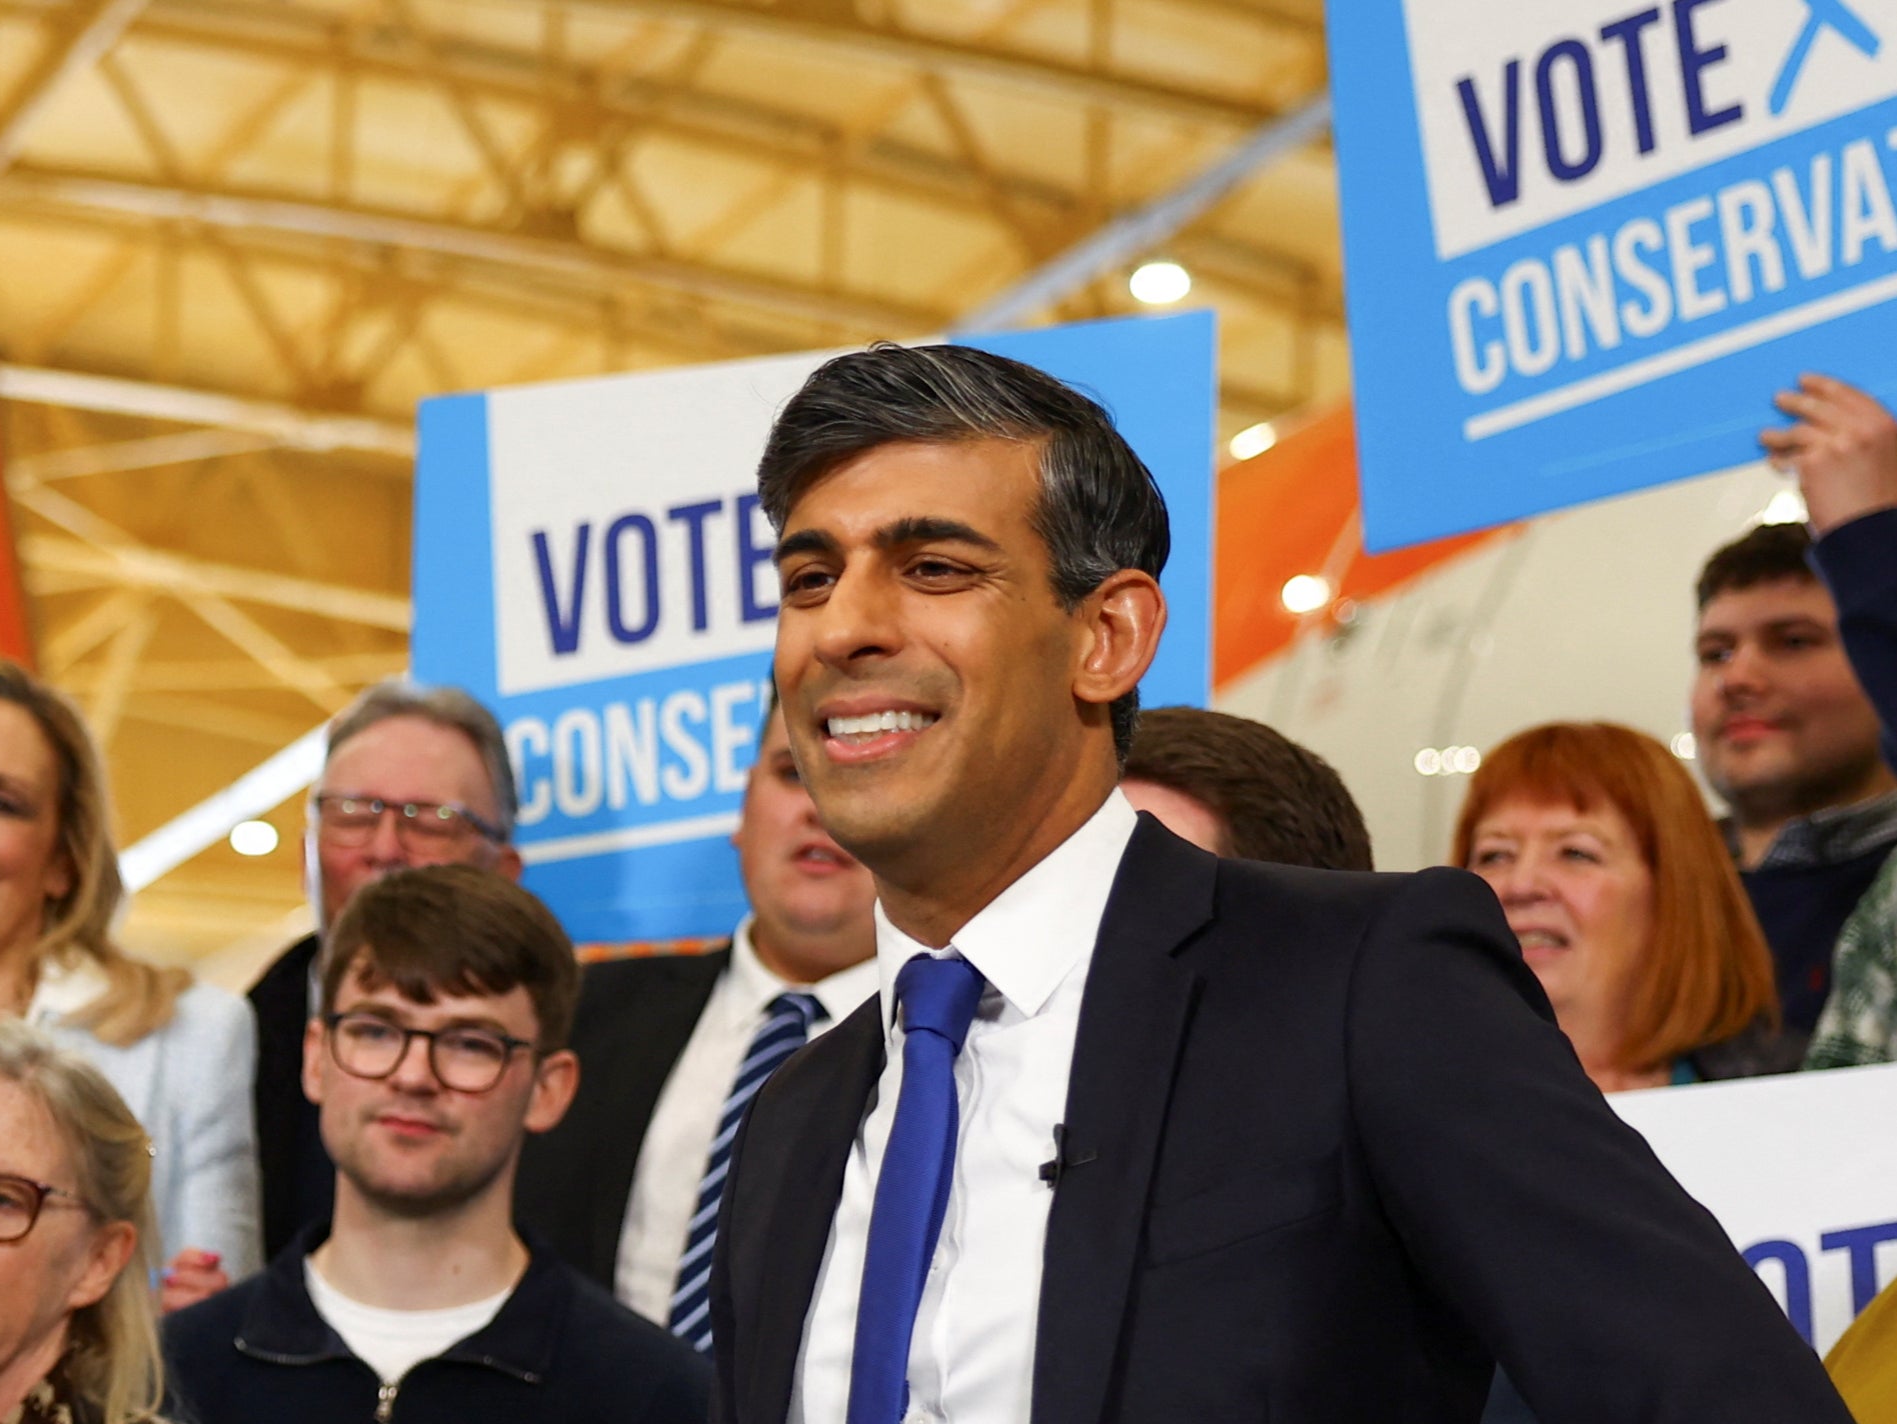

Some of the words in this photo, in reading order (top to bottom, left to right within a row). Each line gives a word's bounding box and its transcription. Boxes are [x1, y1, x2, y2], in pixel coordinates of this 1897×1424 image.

[1456, 0, 1744, 211] VOTE
[1447, 128, 1897, 396] CONSERVA
[531, 492, 780, 657] VOTE
[504, 680, 774, 825] CONSE
